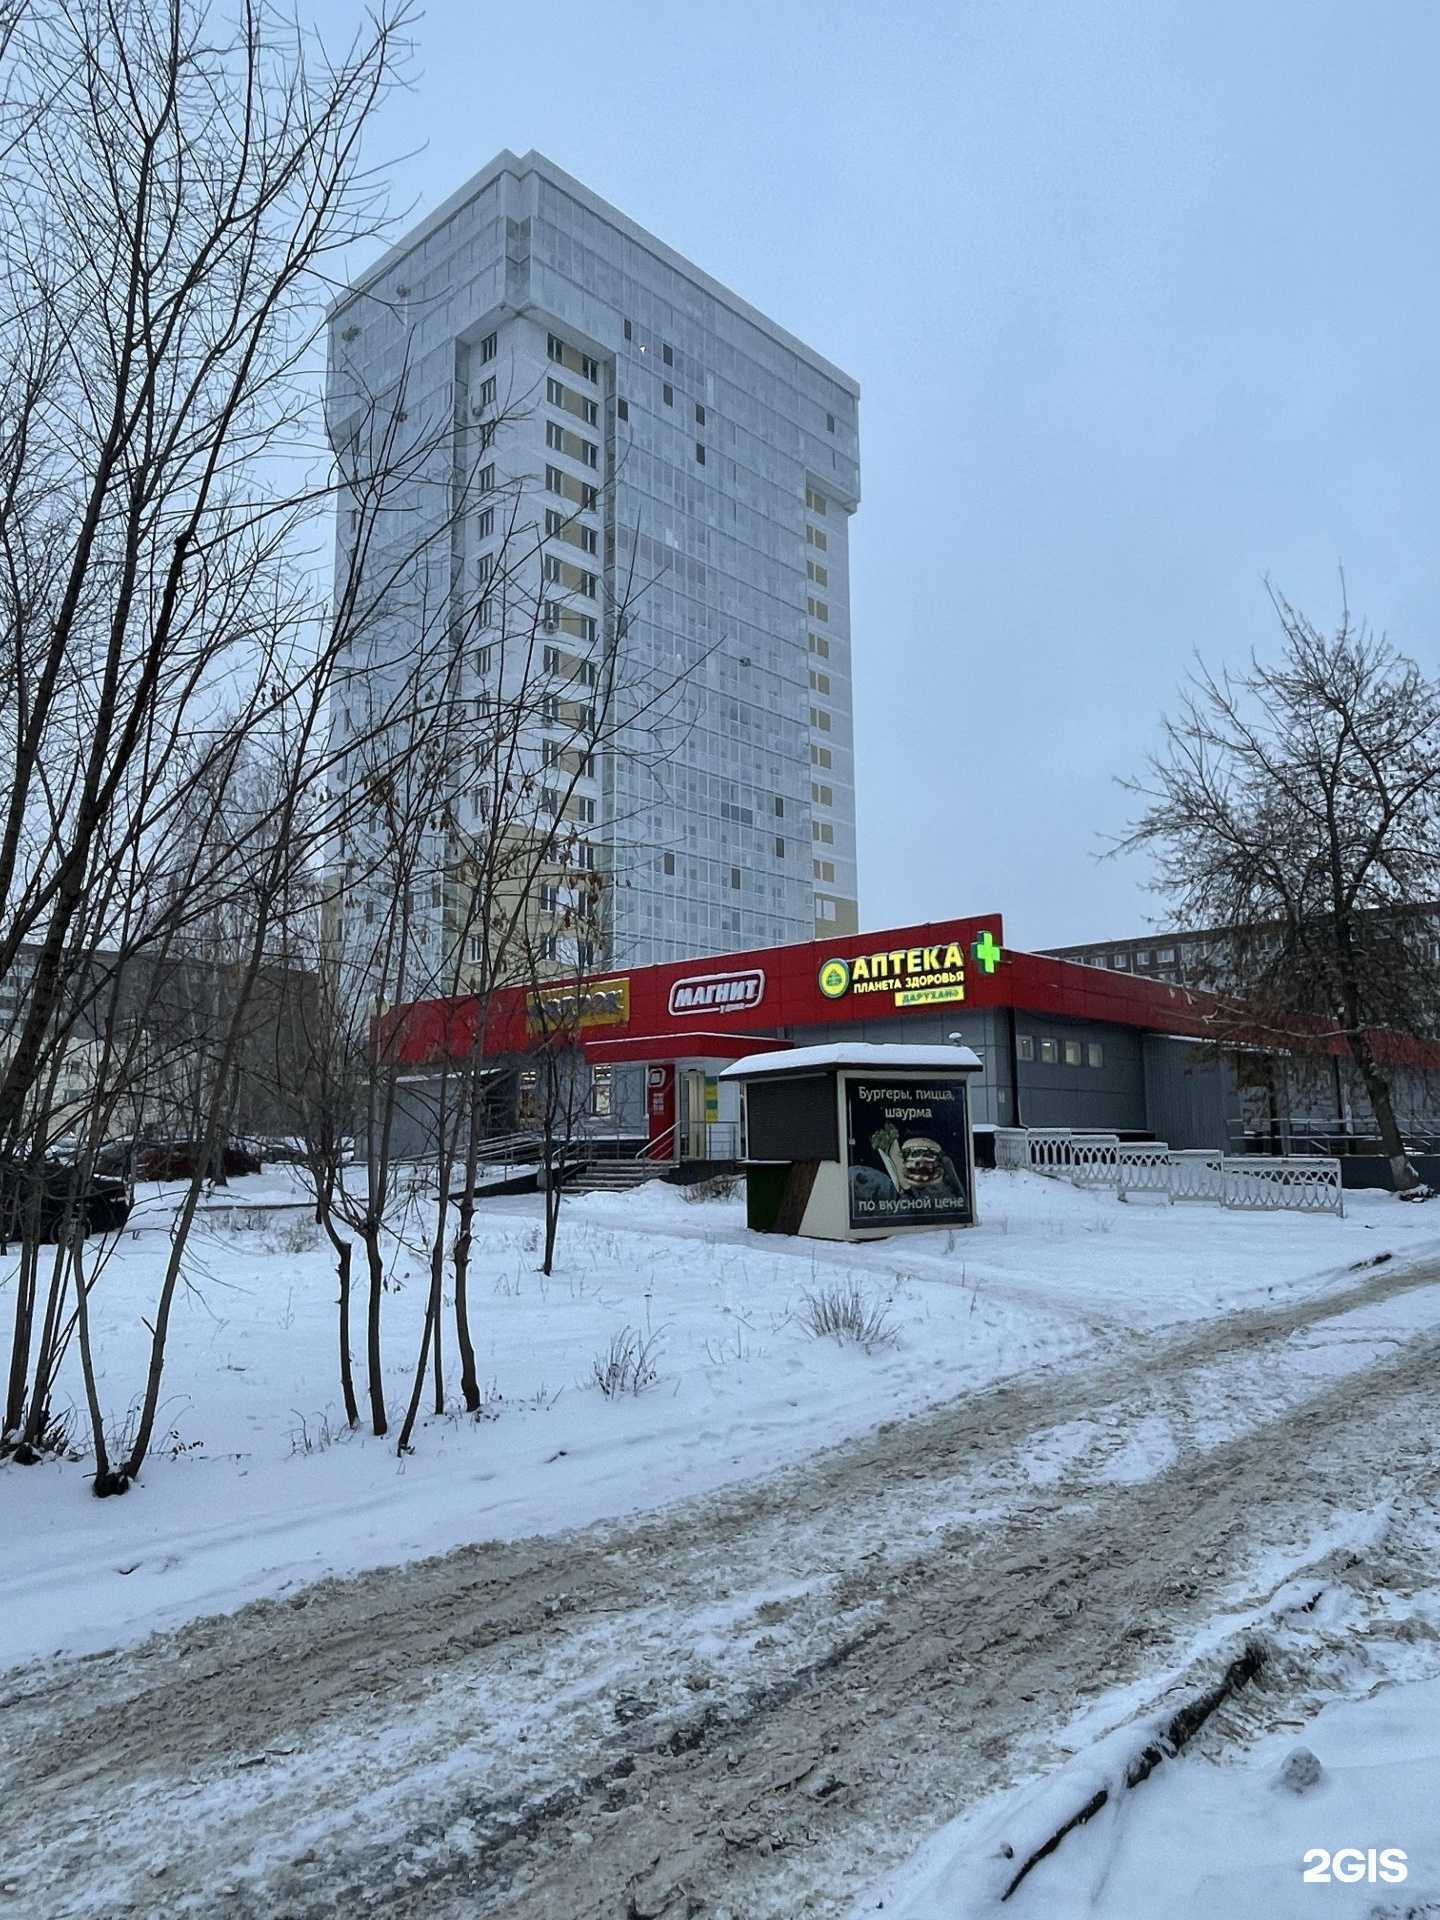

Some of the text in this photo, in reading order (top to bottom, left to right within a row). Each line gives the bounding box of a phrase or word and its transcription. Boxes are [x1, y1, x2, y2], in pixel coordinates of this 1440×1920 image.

[852, 942, 964, 980] АПТЕКА
[853, 970, 964, 993] ПЛАНЕТА ЗДОРОВЬЯ
[674, 979, 758, 1008] МАГНИТ
[858, 1086, 955, 1102] Бургеры, пицца,
[885, 1107, 932, 1121] шаурма
[858, 1195, 964, 1213] по вкусной цене
